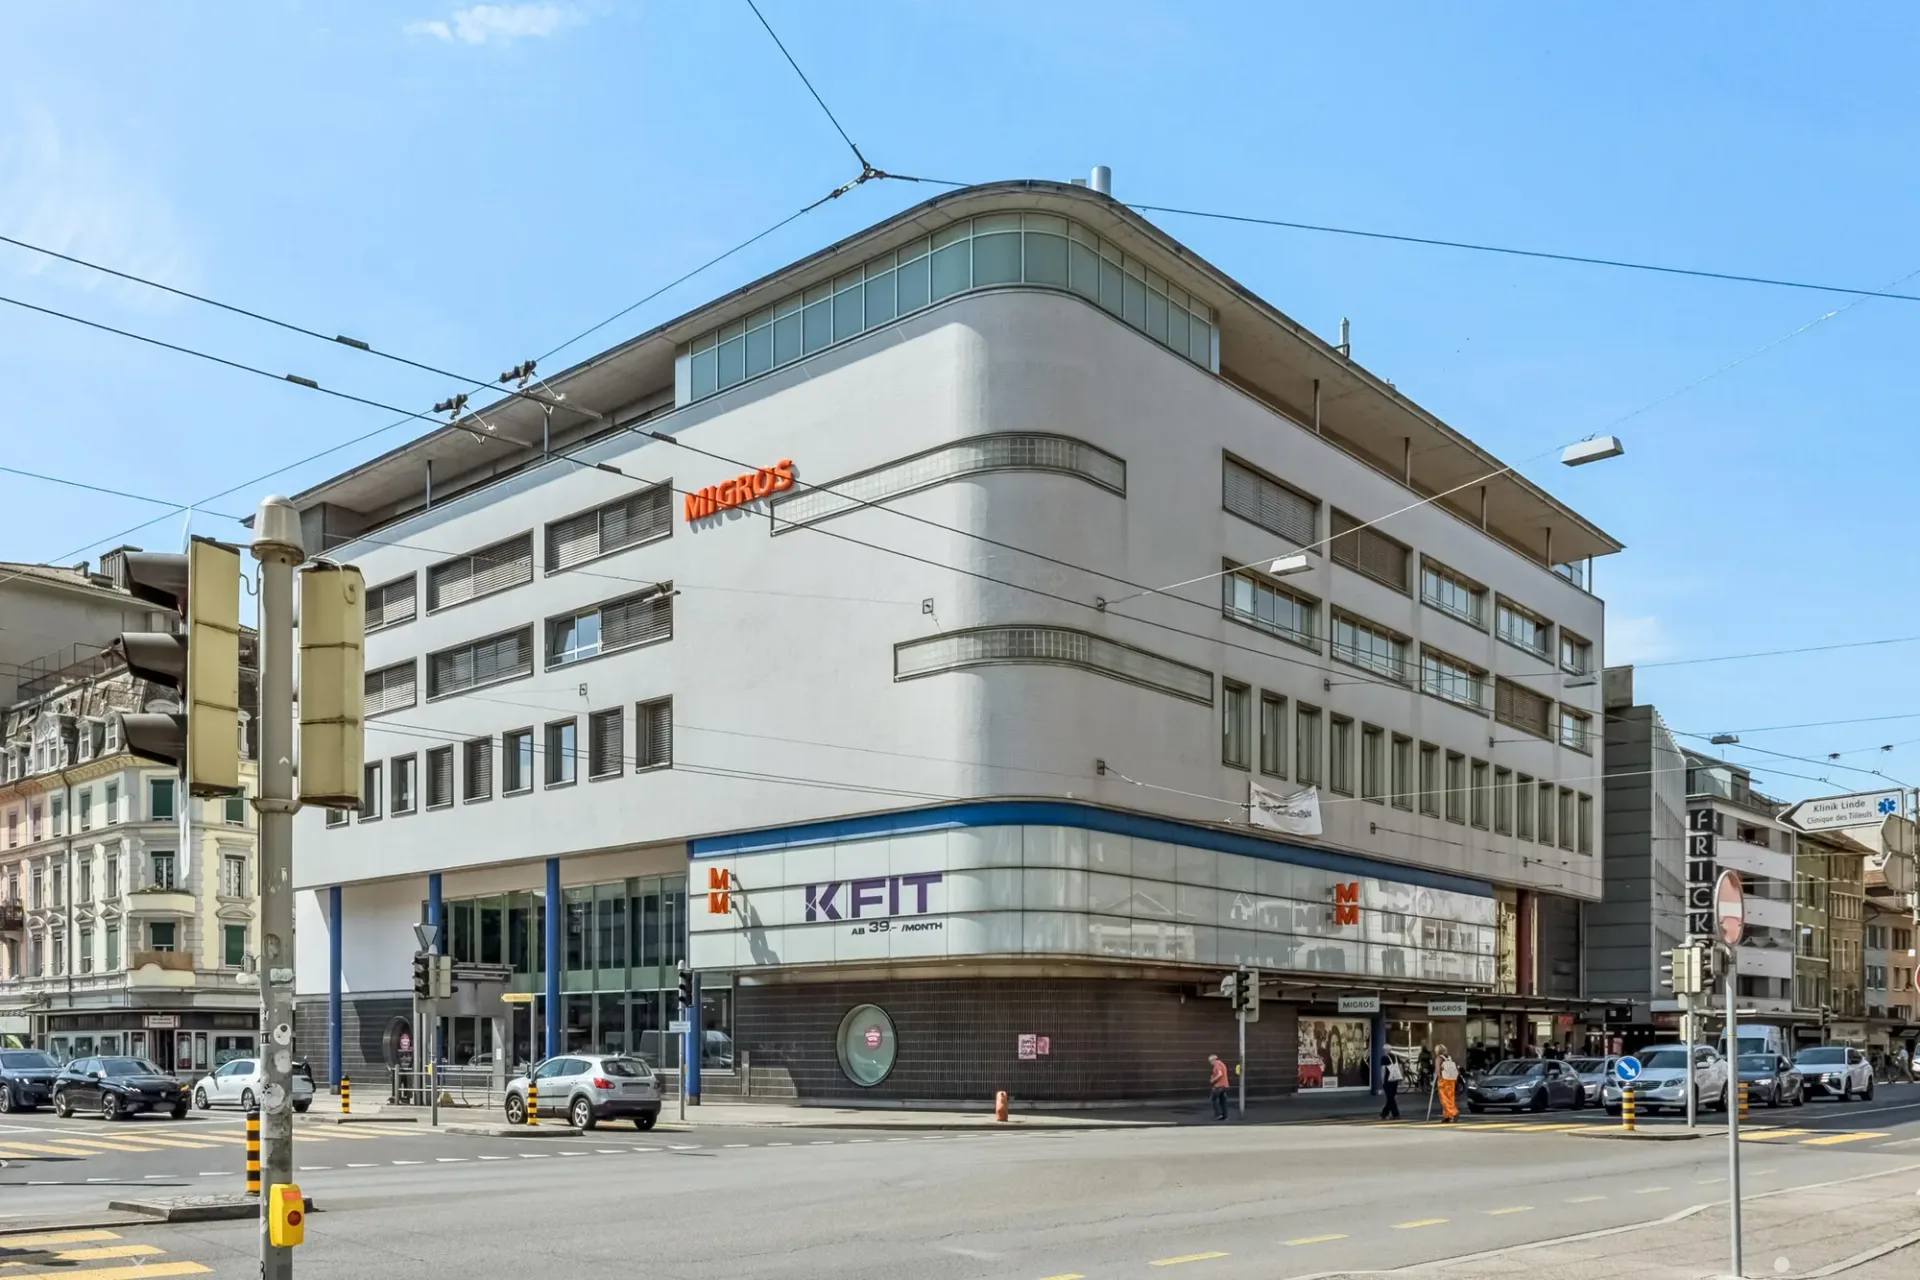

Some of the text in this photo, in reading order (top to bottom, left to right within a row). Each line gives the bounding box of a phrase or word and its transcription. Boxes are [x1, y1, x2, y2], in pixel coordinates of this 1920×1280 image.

[684, 458, 794, 521] MIGROS
[1813, 800, 1866, 812] Klinik Linde
[1806, 815, 1834, 824] Clinique
[1848, 811, 1873, 820] Tilleuls
[805, 873, 943, 922] KFIT
[851, 927, 866, 935] AB
[901, 922, 943, 933] /MONTH
[1342, 1001, 1375, 1009] MIGROS
